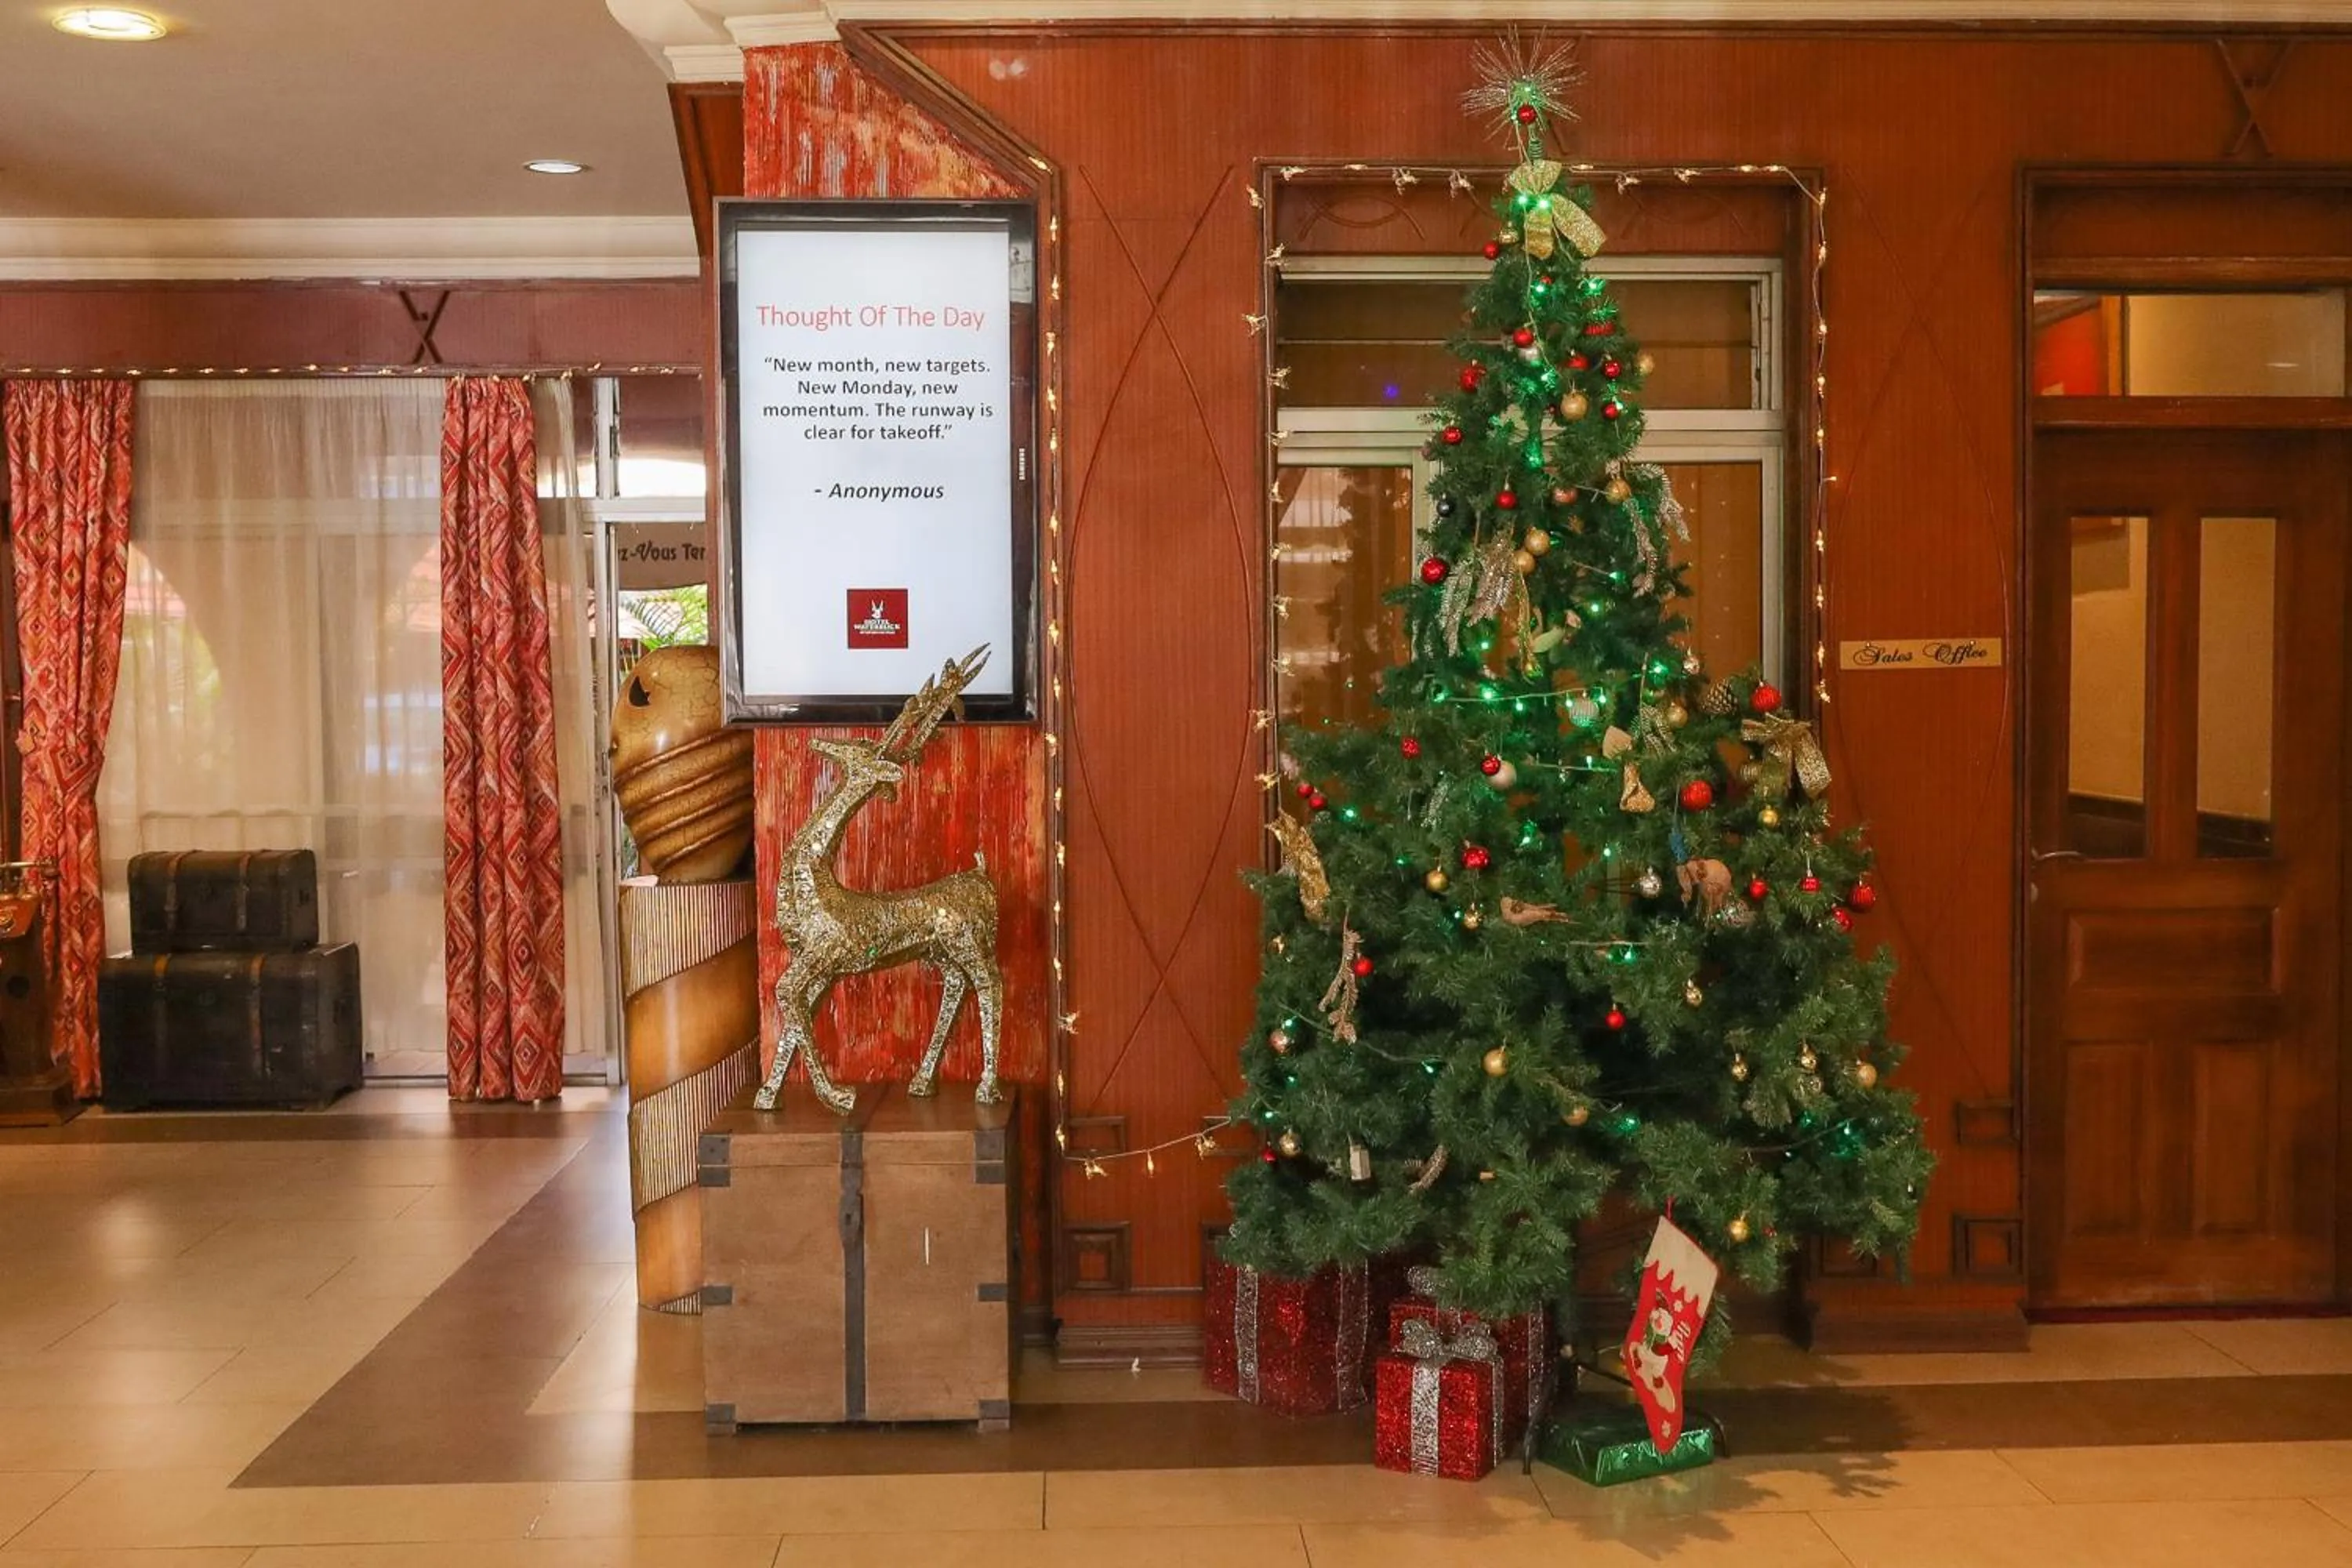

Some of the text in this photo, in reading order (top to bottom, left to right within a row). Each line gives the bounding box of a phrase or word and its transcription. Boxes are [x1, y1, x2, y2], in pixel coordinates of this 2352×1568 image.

[756, 305, 984, 332] Thought Of The Day
[818, 357, 880, 375] month,
[885, 361, 922, 374] new
[926, 357, 990, 376] targets.
[798, 379, 959, 398] New Monday, new
[763, 402, 993, 420] momentum. The runway is
[804, 424, 845, 440] clear
[850, 424, 875, 440] for
[828, 481, 945, 503] Anonymous
[1853, 642, 1987, 666] Sales Office
